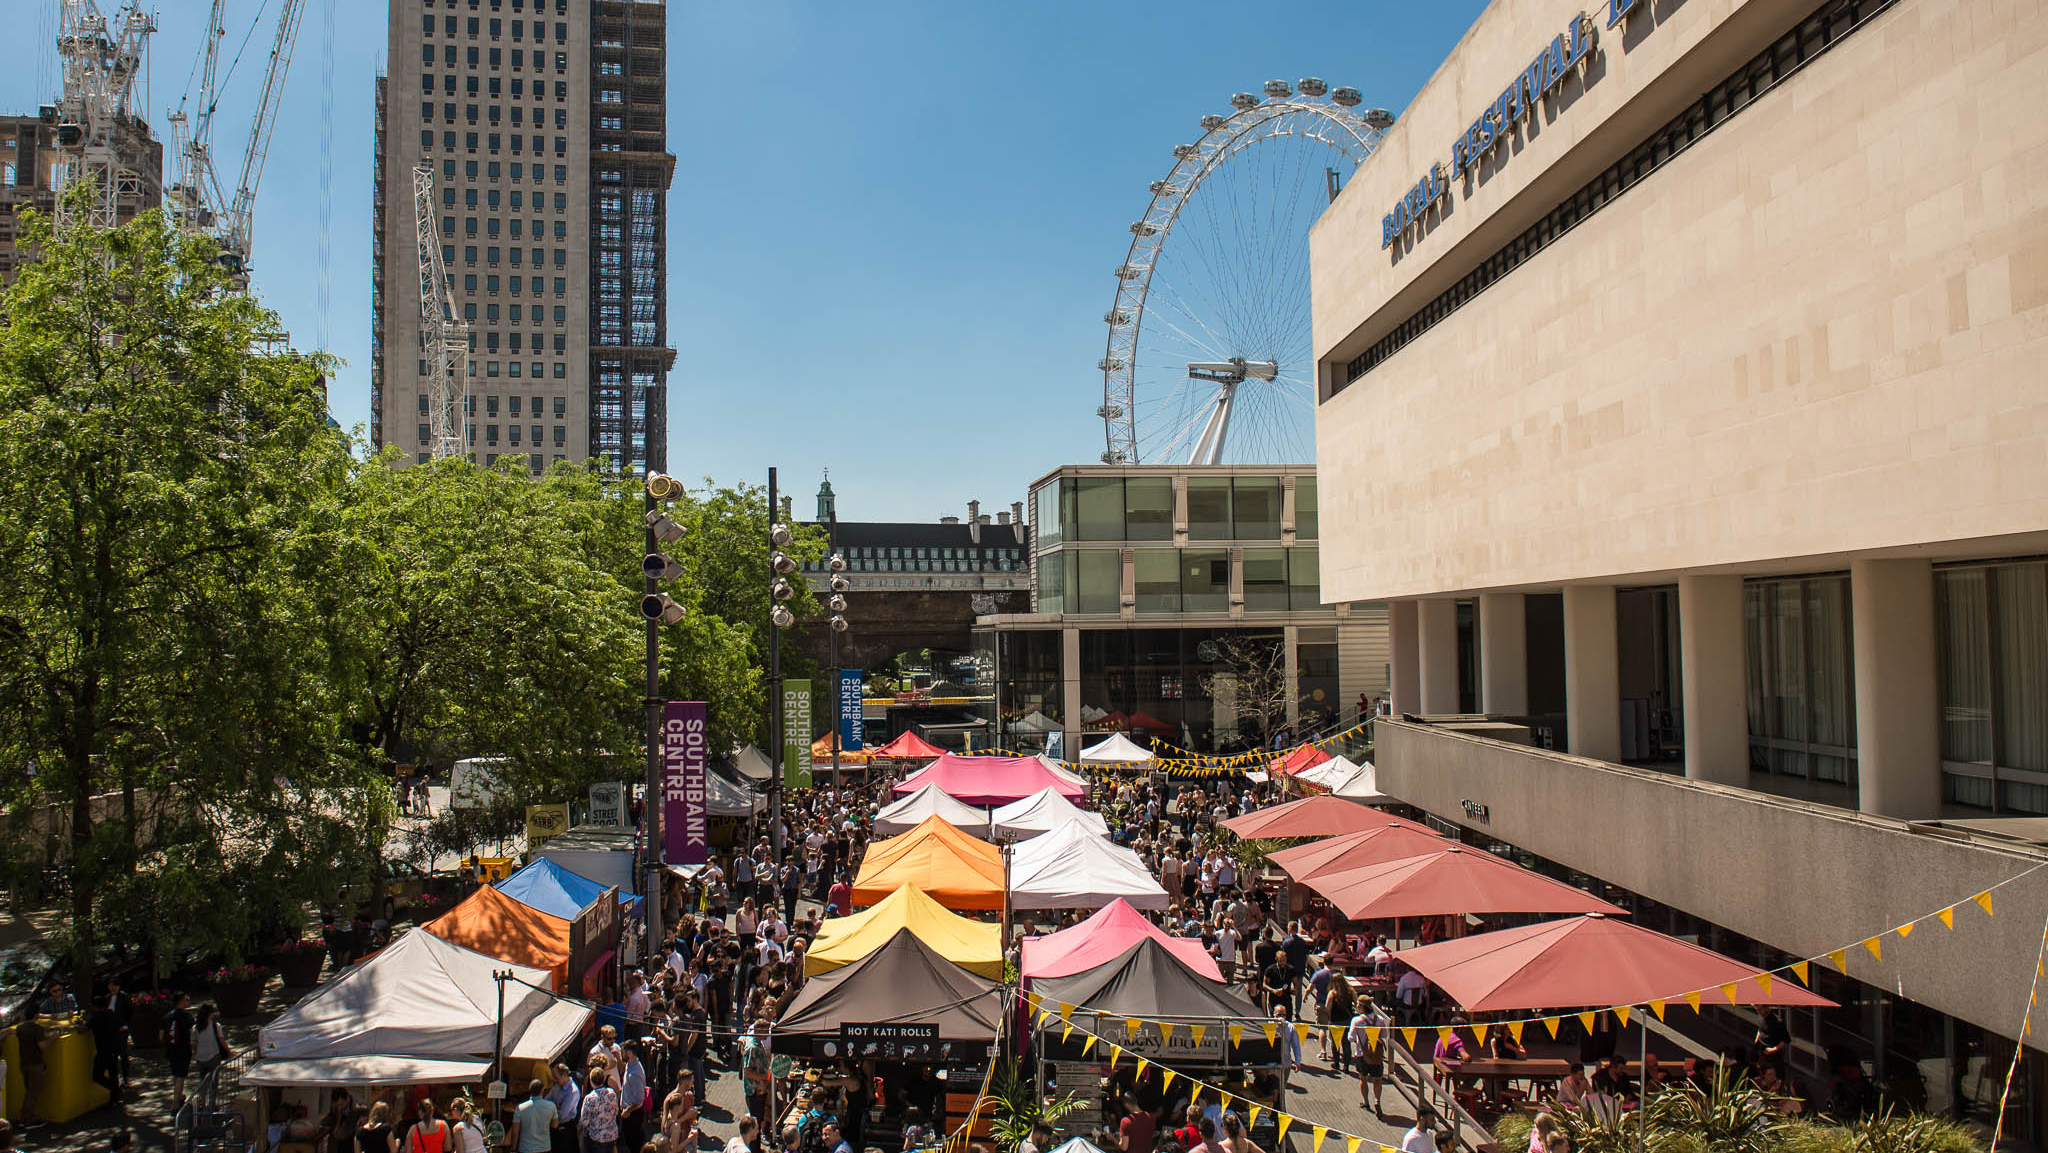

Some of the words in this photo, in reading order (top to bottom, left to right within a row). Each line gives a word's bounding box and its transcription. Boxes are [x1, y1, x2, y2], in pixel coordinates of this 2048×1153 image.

[1381, 163, 1444, 250] ROYAL
[1452, 12, 1591, 181] FESTIVAL
[785, 691, 797, 747] CENTRE
[841, 678, 851, 720] CENTRE
[852, 678, 862, 742] SOUTHBANK
[666, 719, 684, 802] CENTRE
[797, 691, 811, 776] SOUTHBANK
[593, 808, 618, 819] STREET
[686, 719, 705, 848] SOUTHBANK
[847, 1027, 868, 1036] HOT
[873, 1027, 896, 1037] KATI
[901, 1028, 932, 1037] ROLLS
